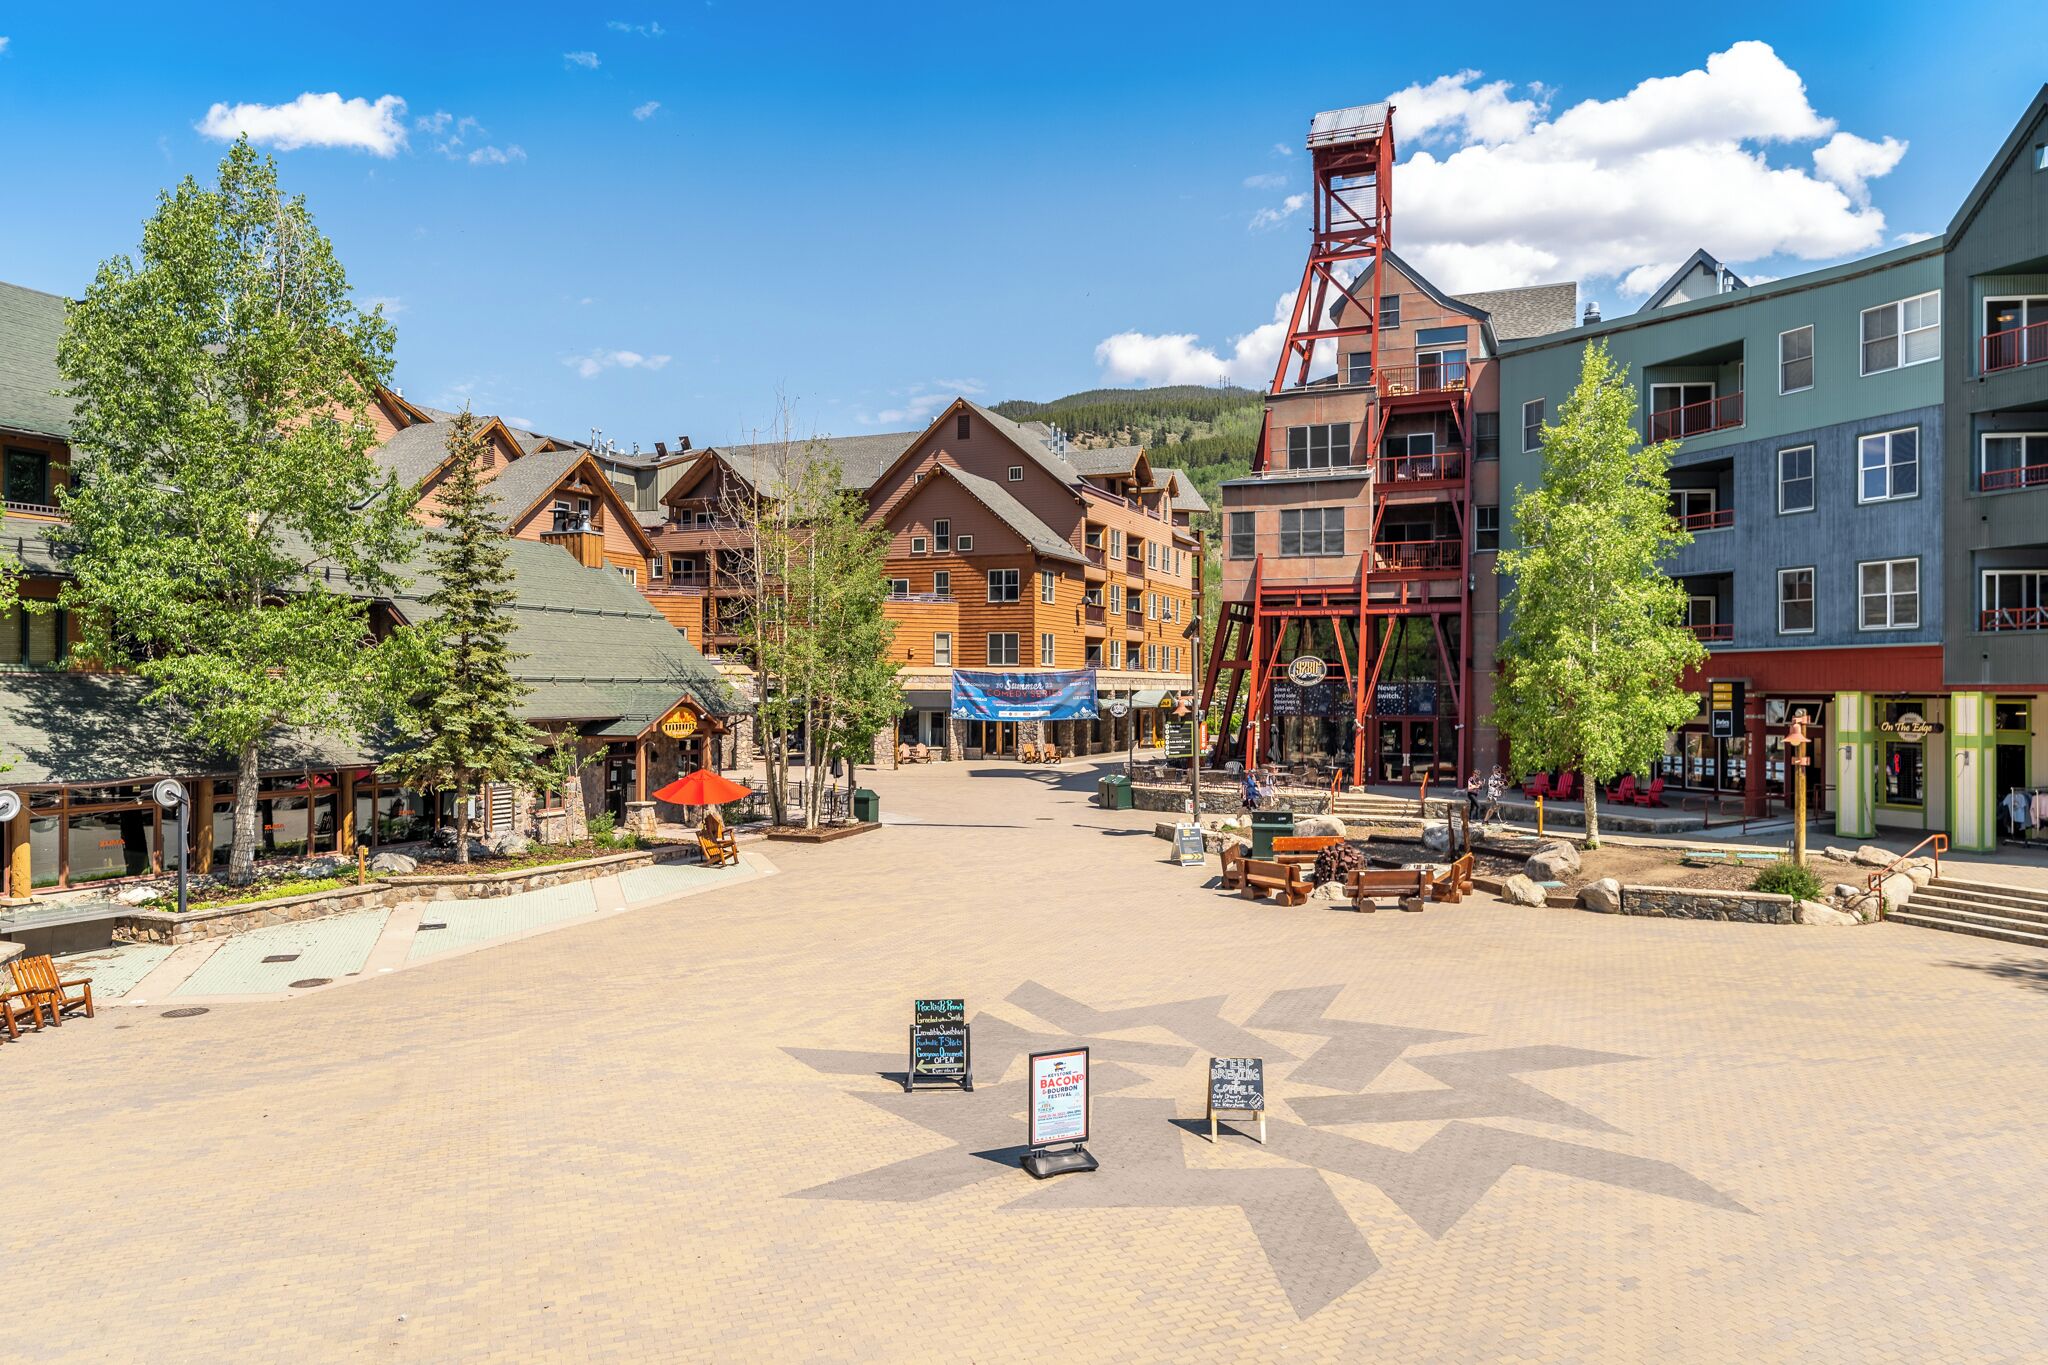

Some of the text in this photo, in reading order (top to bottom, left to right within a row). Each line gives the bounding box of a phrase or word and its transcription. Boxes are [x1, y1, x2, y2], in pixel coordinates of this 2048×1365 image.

[1004, 679, 1044, 691] Summer
[986, 688, 1028, 698] COMEDY
[1030, 688, 1062, 698] SERIES
[1881, 721, 1932, 736] On The Edge
[1215, 1058, 1254, 1069] STEEP
[1048, 1070, 1072, 1078] KEYSTONE
[1211, 1068, 1260, 1081] BREWING
[1040, 1075, 1079, 1089] BACON
[1047, 1085, 1078, 1094] BOURBON
[1213, 1084, 1256, 1095] COFFEE
